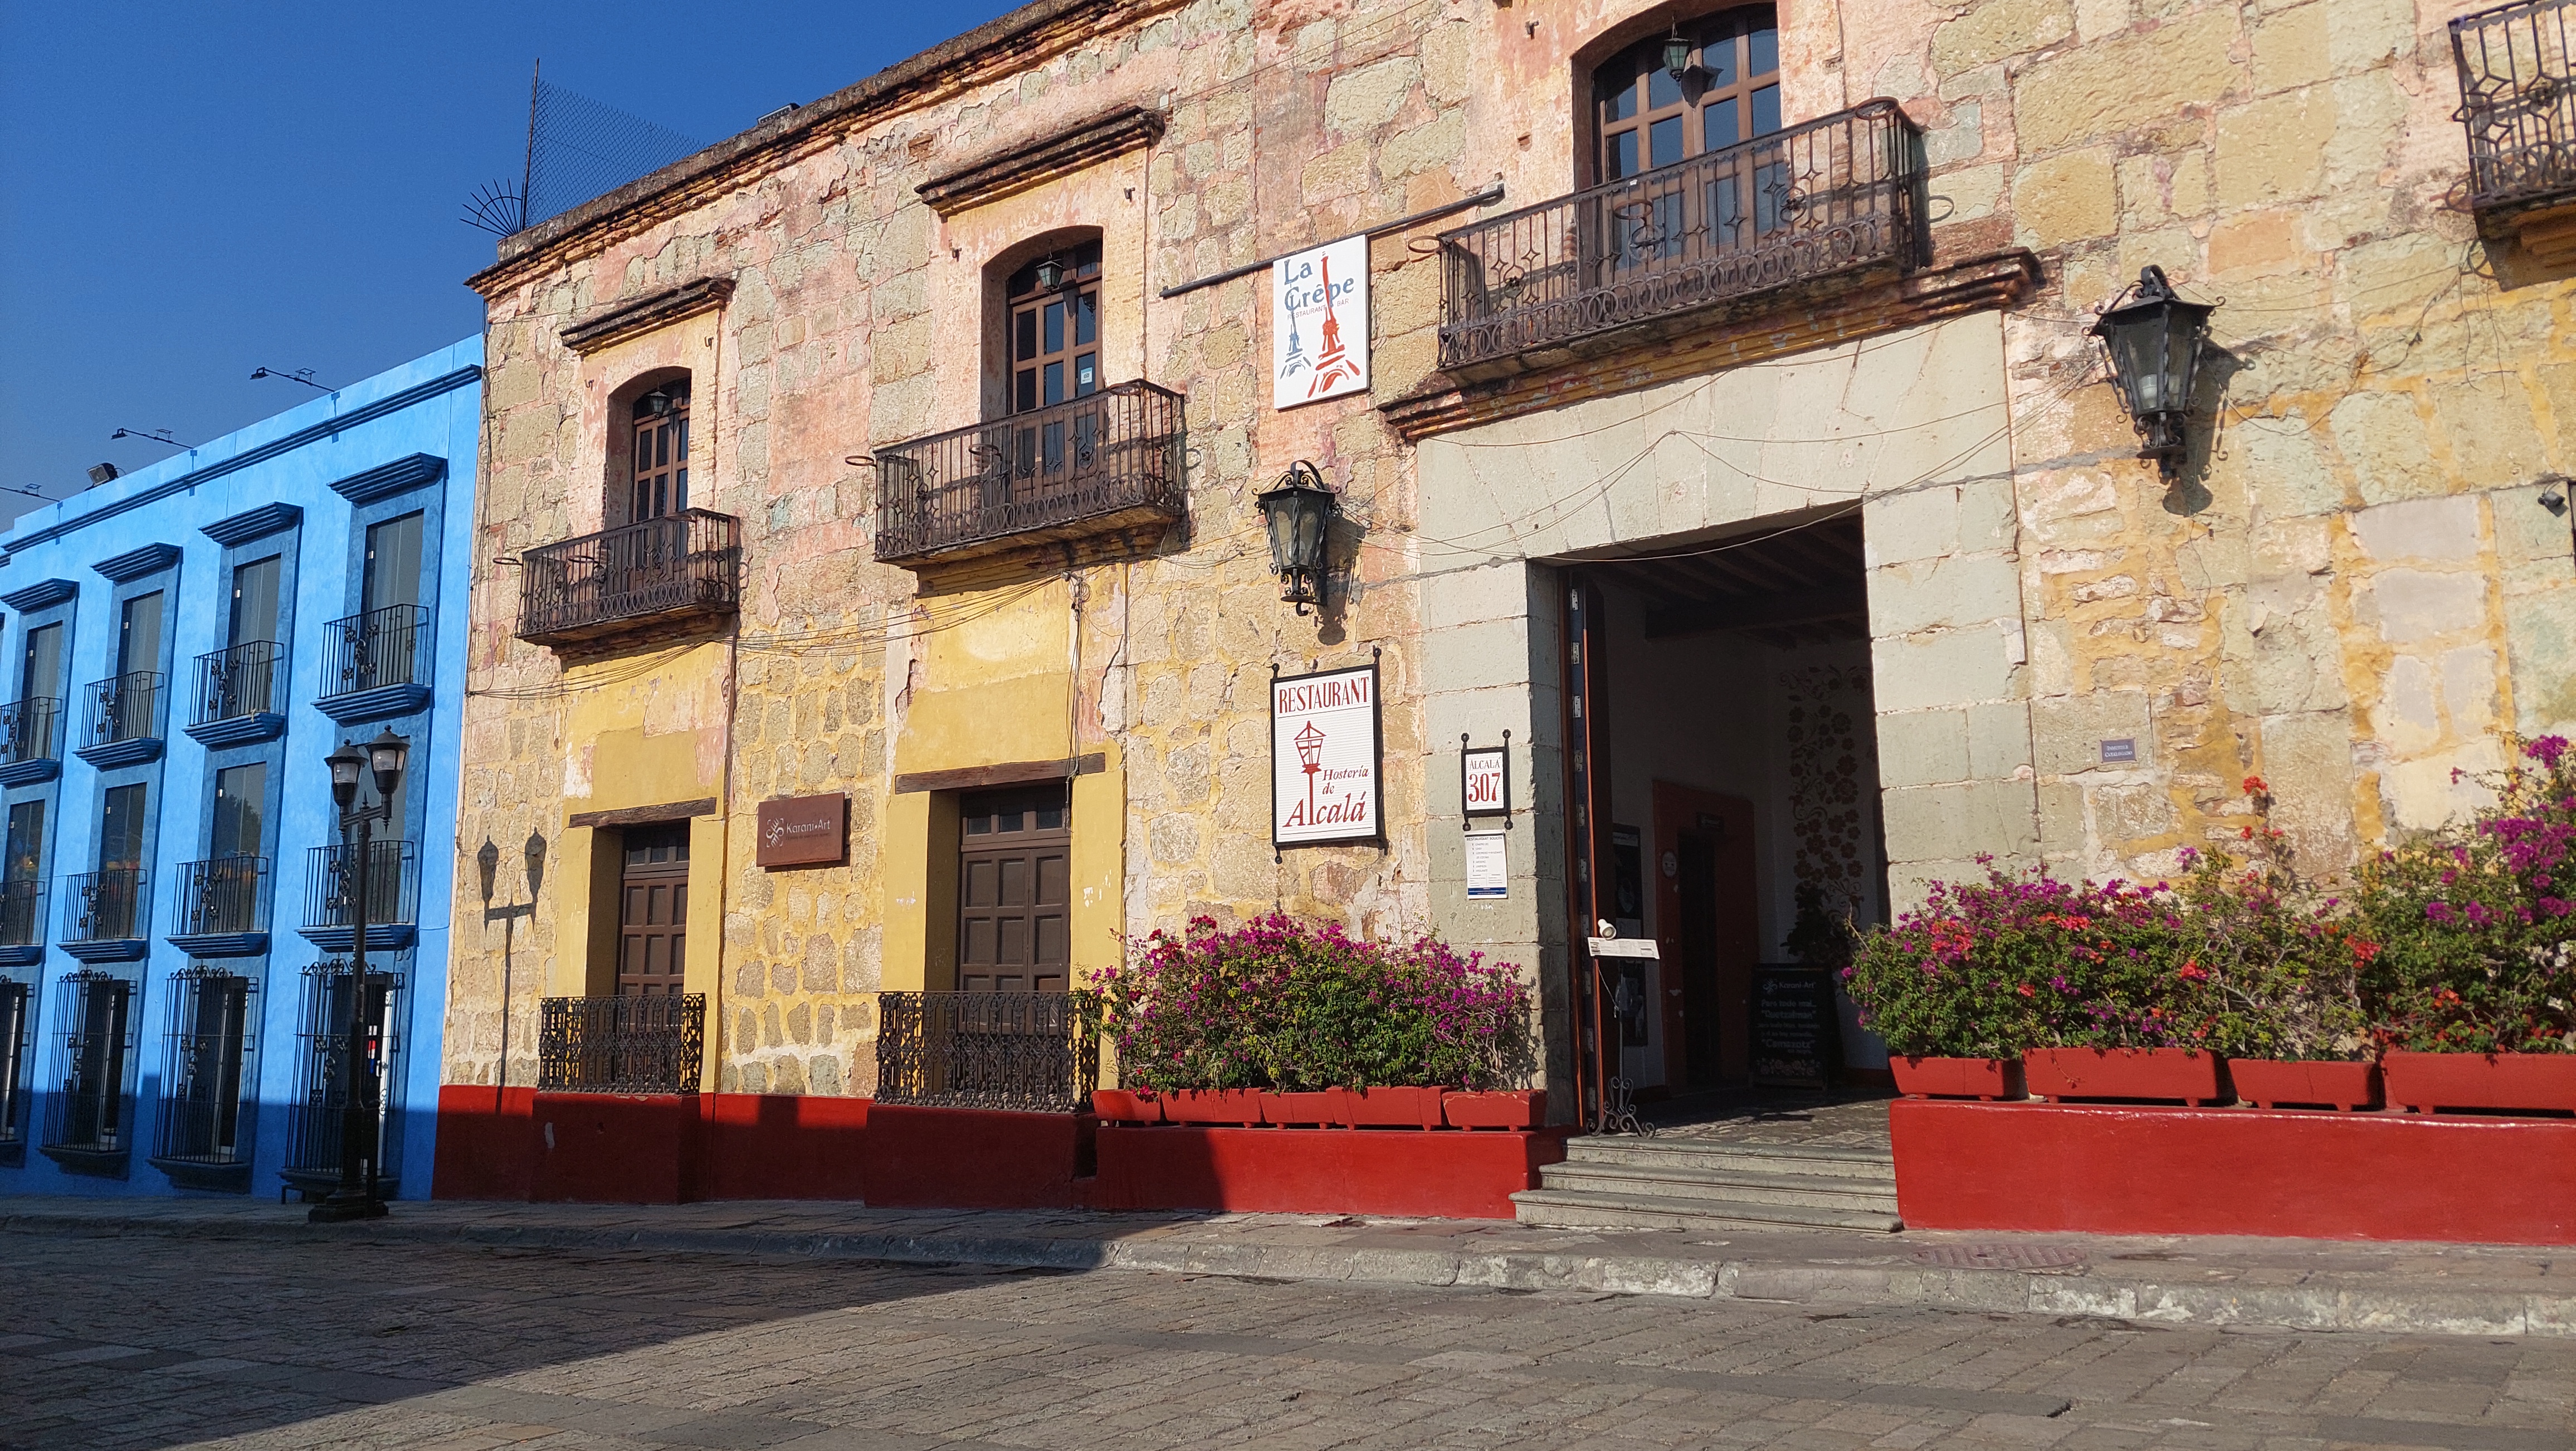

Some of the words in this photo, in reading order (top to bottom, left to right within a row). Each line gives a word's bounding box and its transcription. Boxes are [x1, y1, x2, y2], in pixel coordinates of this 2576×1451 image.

[1284, 259, 1313, 285] La
[1285, 277, 1354, 311] Crêpe
[1287, 304, 1326, 320] RESTAURANT
[1337, 298, 1349, 307] BAR
[1279, 676, 1369, 713] RESTAURANT
[1322, 765, 1369, 781] Hostería
[1470, 757, 1501, 770] ALCALÁ
[1322, 782, 1335, 795] de
[1468, 772, 1500, 802] 307
[1282, 791, 1367, 827] Alcalá
